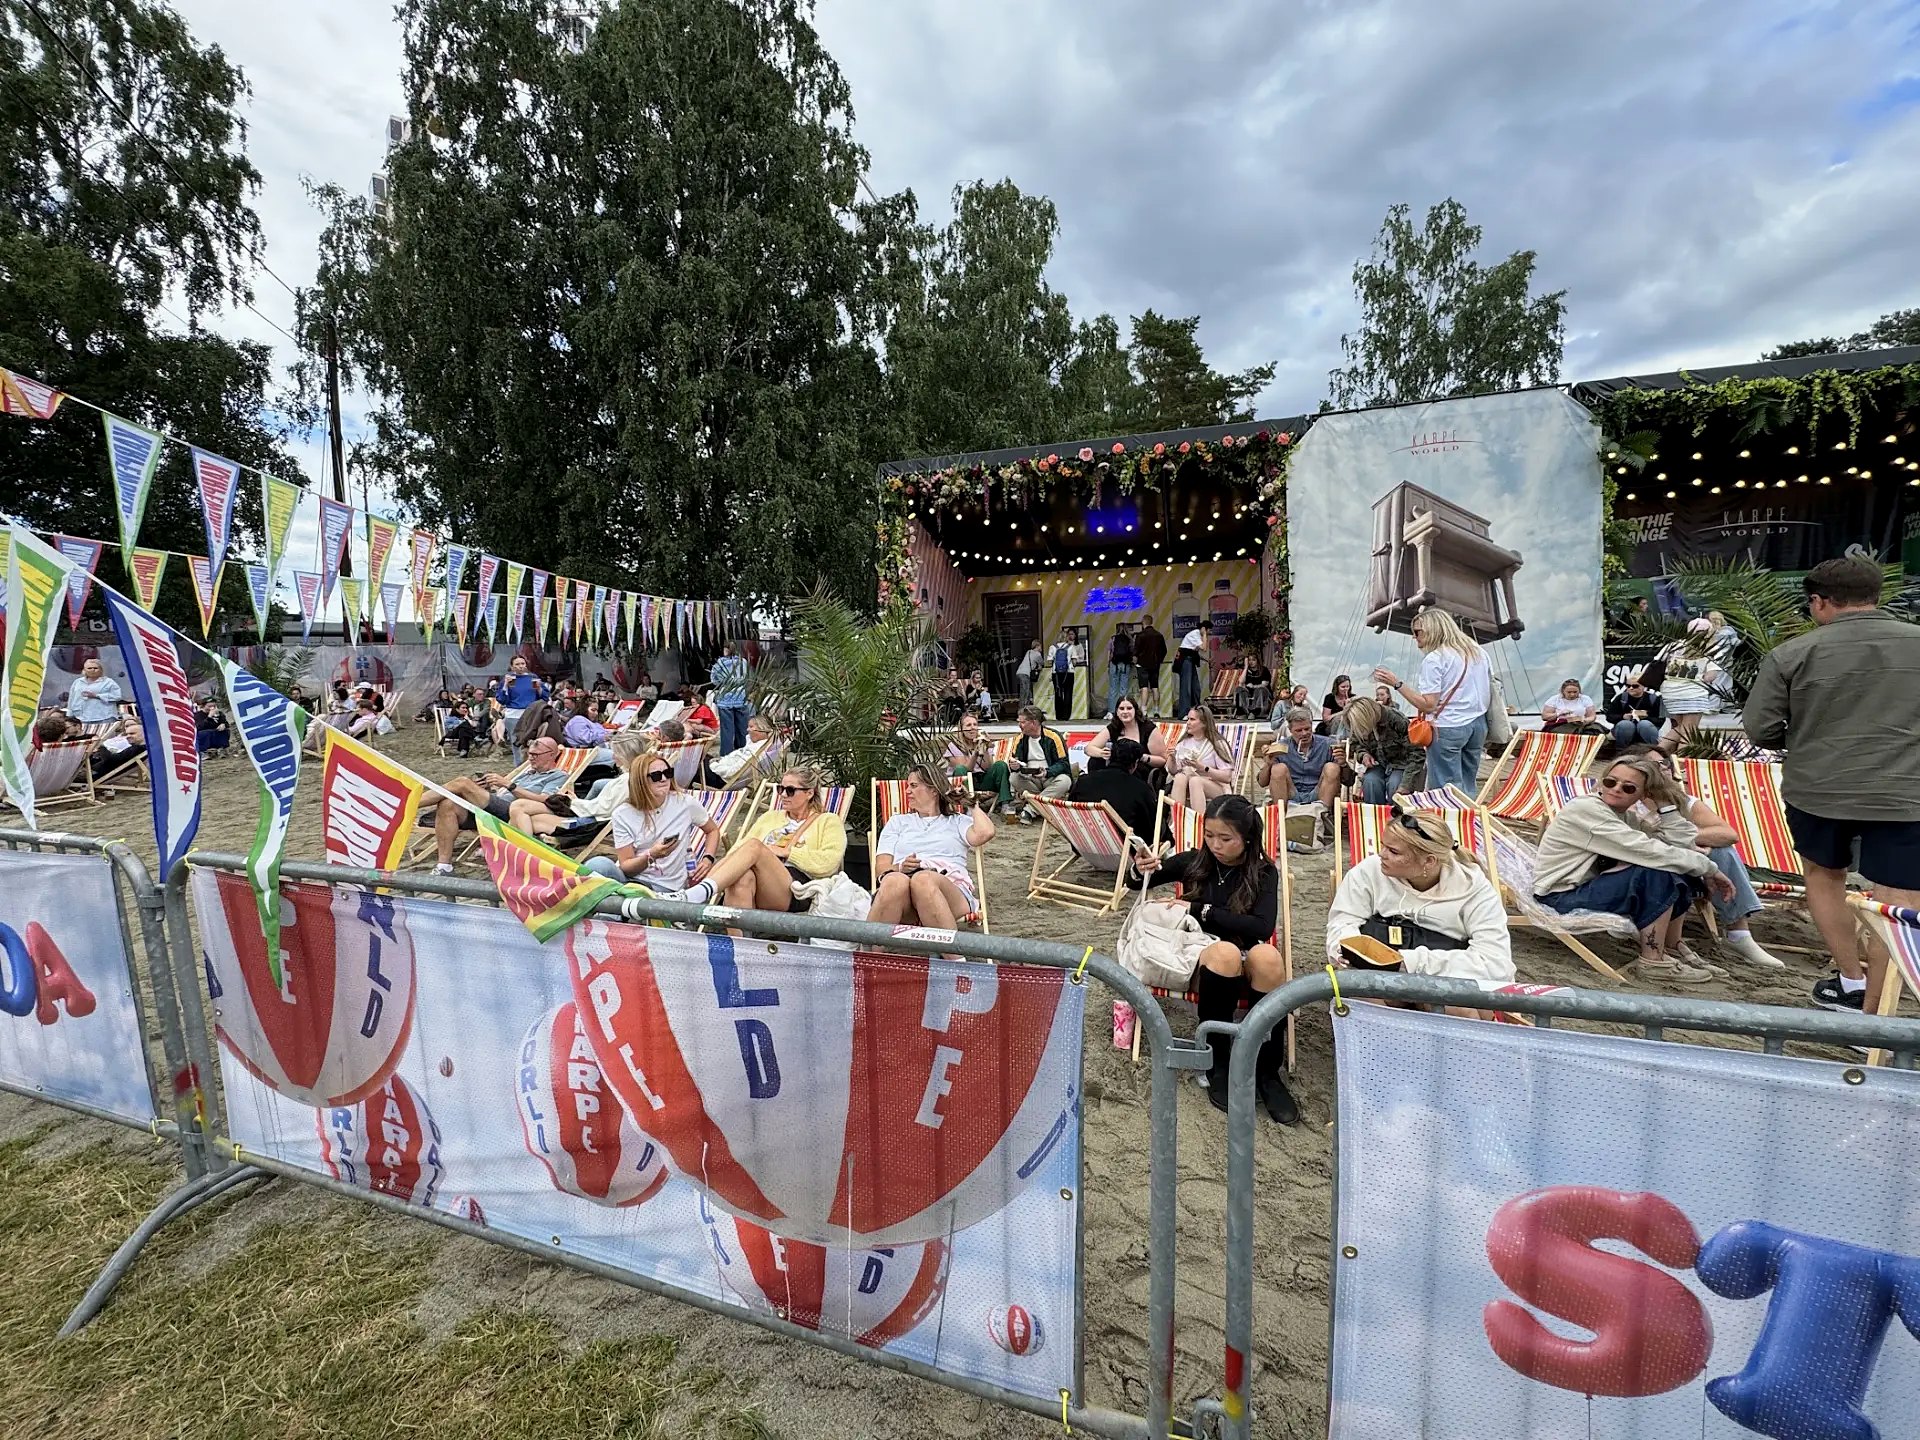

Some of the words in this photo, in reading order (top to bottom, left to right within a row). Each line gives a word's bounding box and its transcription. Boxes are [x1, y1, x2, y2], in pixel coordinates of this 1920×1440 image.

[1413, 430, 1456, 447] KARPE
[1411, 445, 1459, 455] WORLD
[1724, 507, 1786, 525] KARPE
[1721, 527, 1788, 537] WORLD
